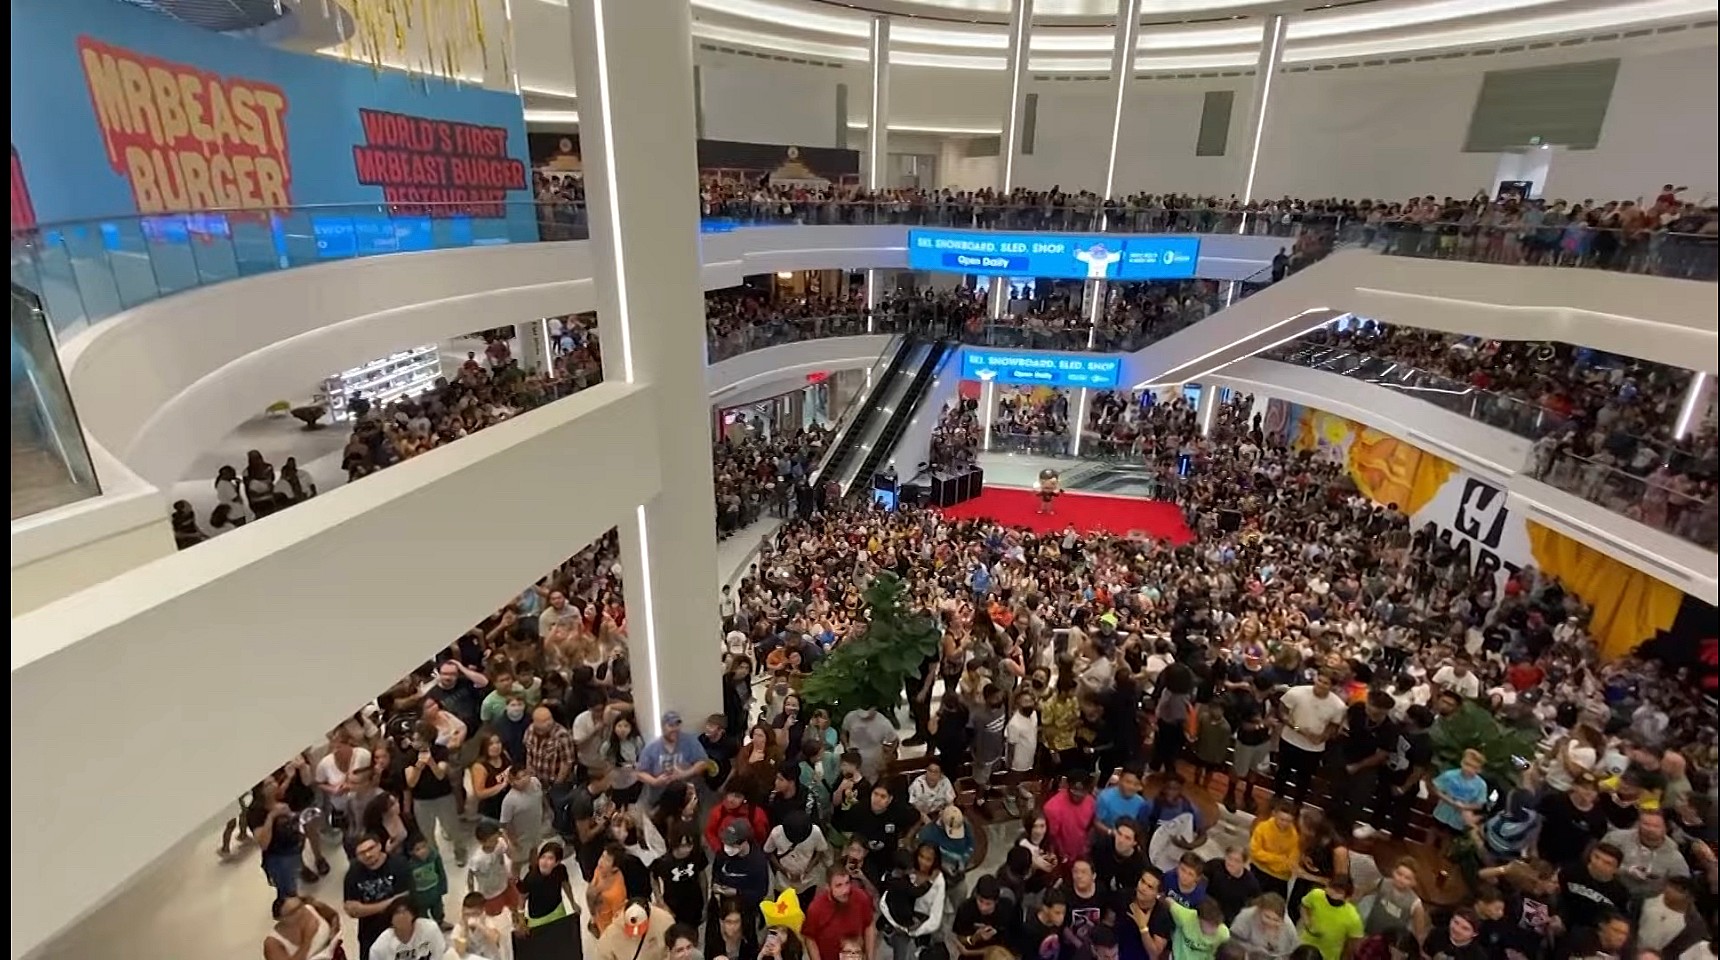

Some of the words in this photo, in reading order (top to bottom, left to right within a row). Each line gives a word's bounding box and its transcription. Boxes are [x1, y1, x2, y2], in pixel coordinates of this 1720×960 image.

[82, 48, 288, 165] MRBEAST
[361, 112, 453, 152] WORLD'S
[455, 126, 507, 157] FIRST
[125, 146, 290, 214] BURGER
[355, 148, 448, 185] MRBEAST
[451, 158, 525, 189] BURGER
[957, 255, 981, 266] Open
[982, 257, 1009, 269] Daily
